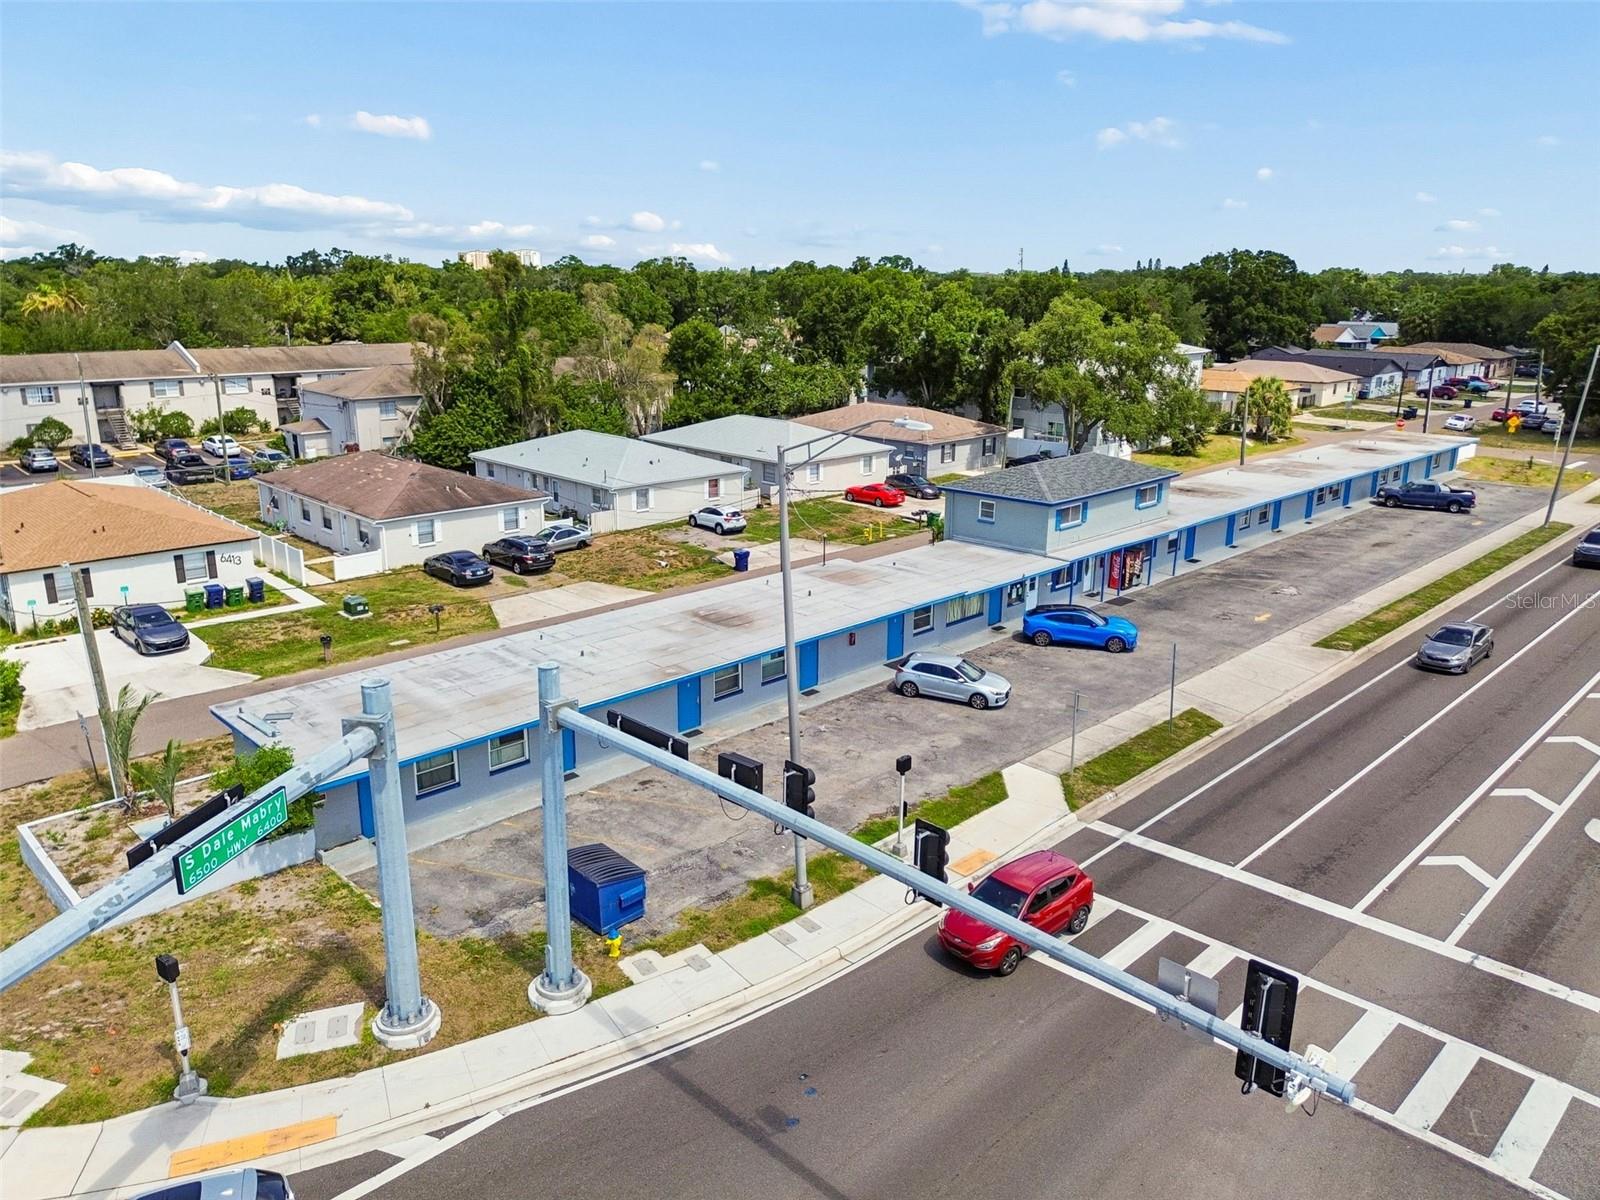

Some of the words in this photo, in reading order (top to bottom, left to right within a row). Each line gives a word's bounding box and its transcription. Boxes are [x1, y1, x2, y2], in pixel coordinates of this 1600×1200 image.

[220, 553, 242, 565] 6413
[184, 854, 195, 870] S
[201, 829, 234, 859] Dale
[241, 796, 281, 832] Mabry
[189, 857, 218, 884] 6500
[226, 836, 248, 858] HWY
[257, 812, 282, 836] 6400
